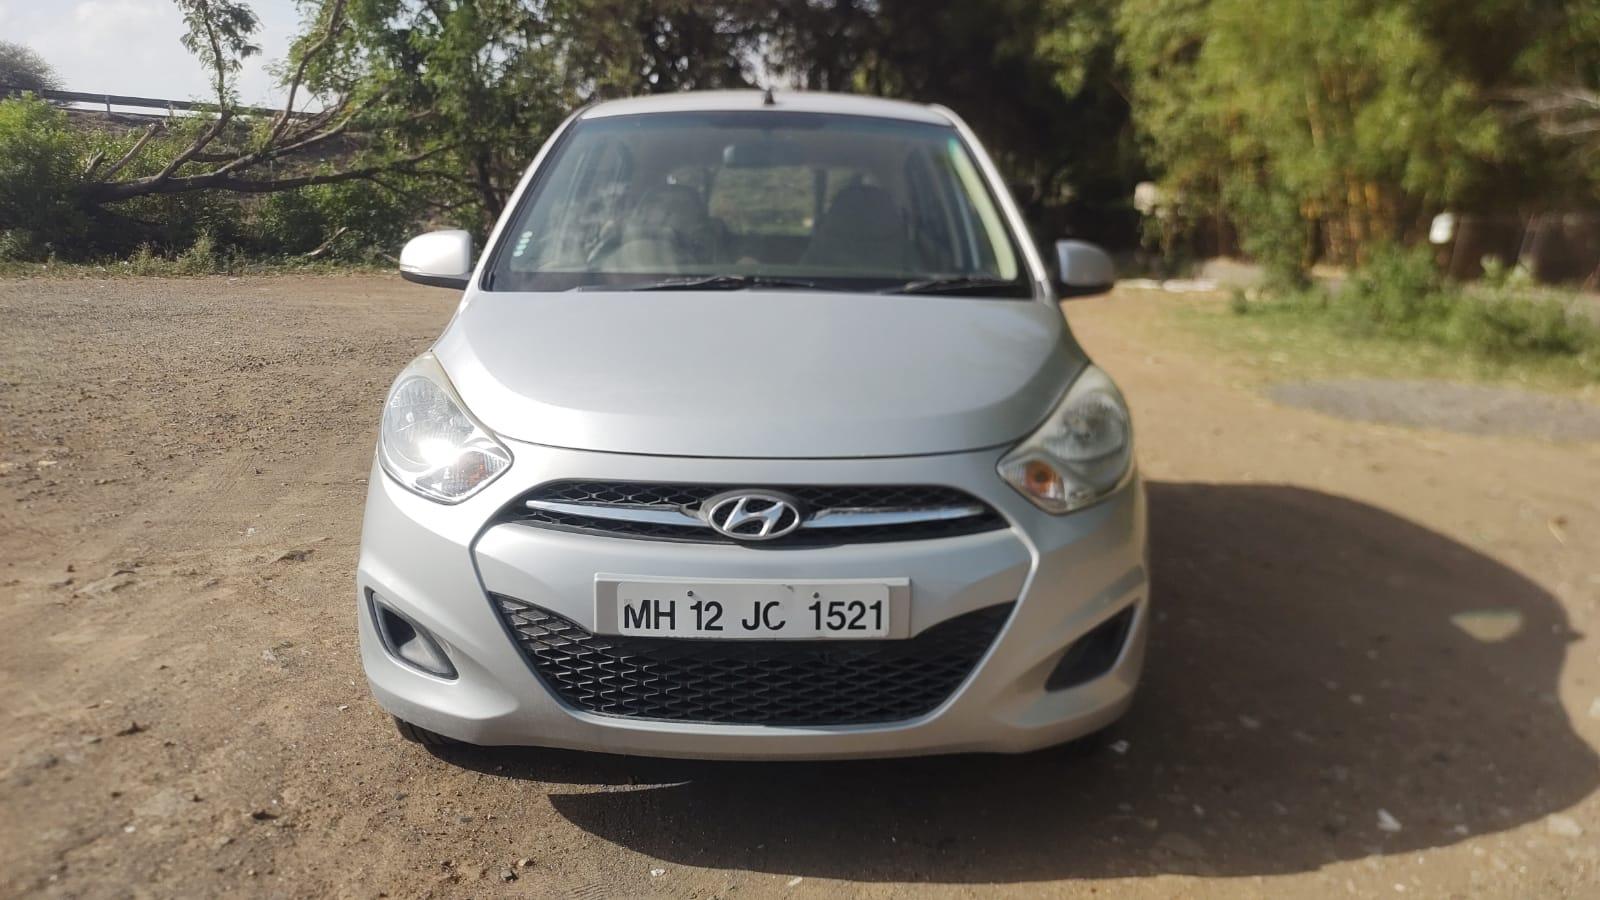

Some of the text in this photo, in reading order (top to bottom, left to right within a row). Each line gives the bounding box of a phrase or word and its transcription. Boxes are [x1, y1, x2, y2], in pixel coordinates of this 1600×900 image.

[623, 599, 882, 631] MH 12 JC 1521
